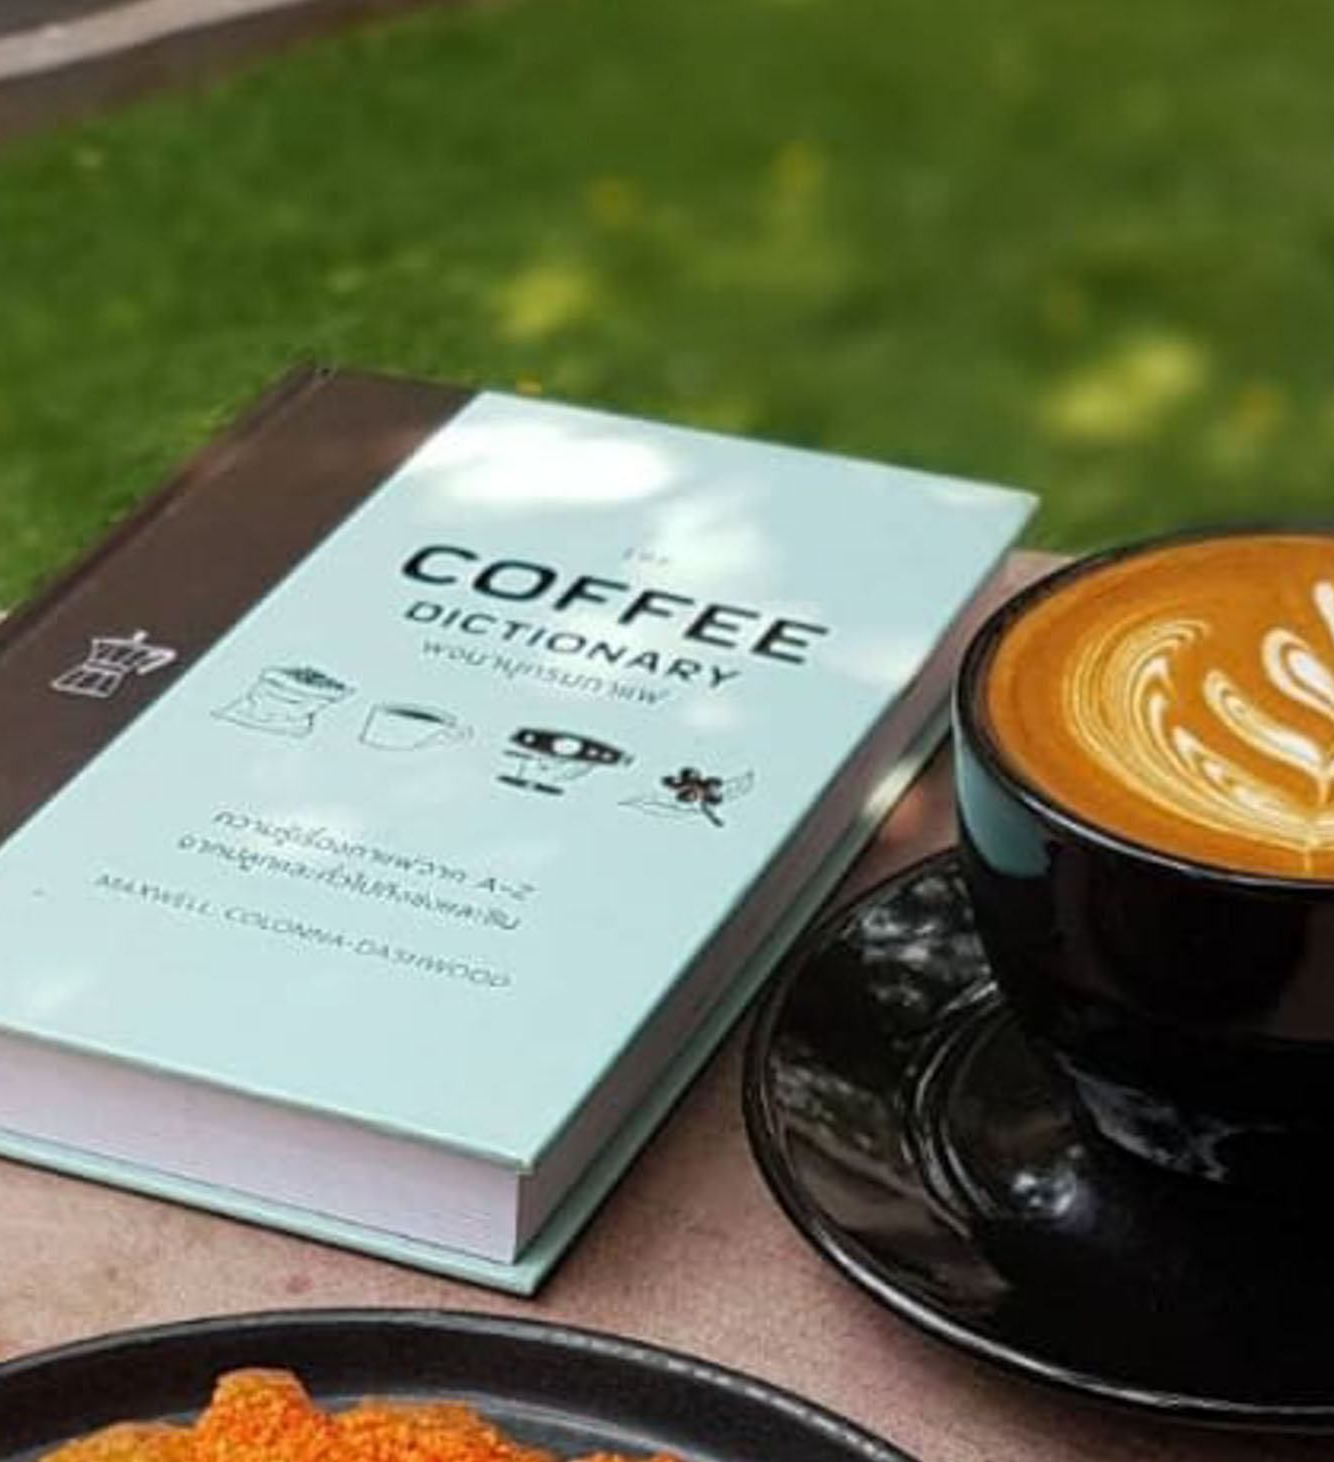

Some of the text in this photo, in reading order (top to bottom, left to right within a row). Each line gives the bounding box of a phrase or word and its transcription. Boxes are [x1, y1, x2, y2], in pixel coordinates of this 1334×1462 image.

[401, 544, 830, 666] COFFEE
[404, 600, 743, 689] DICTIONARY
[94, 872, 215, 917] MAXWELL
